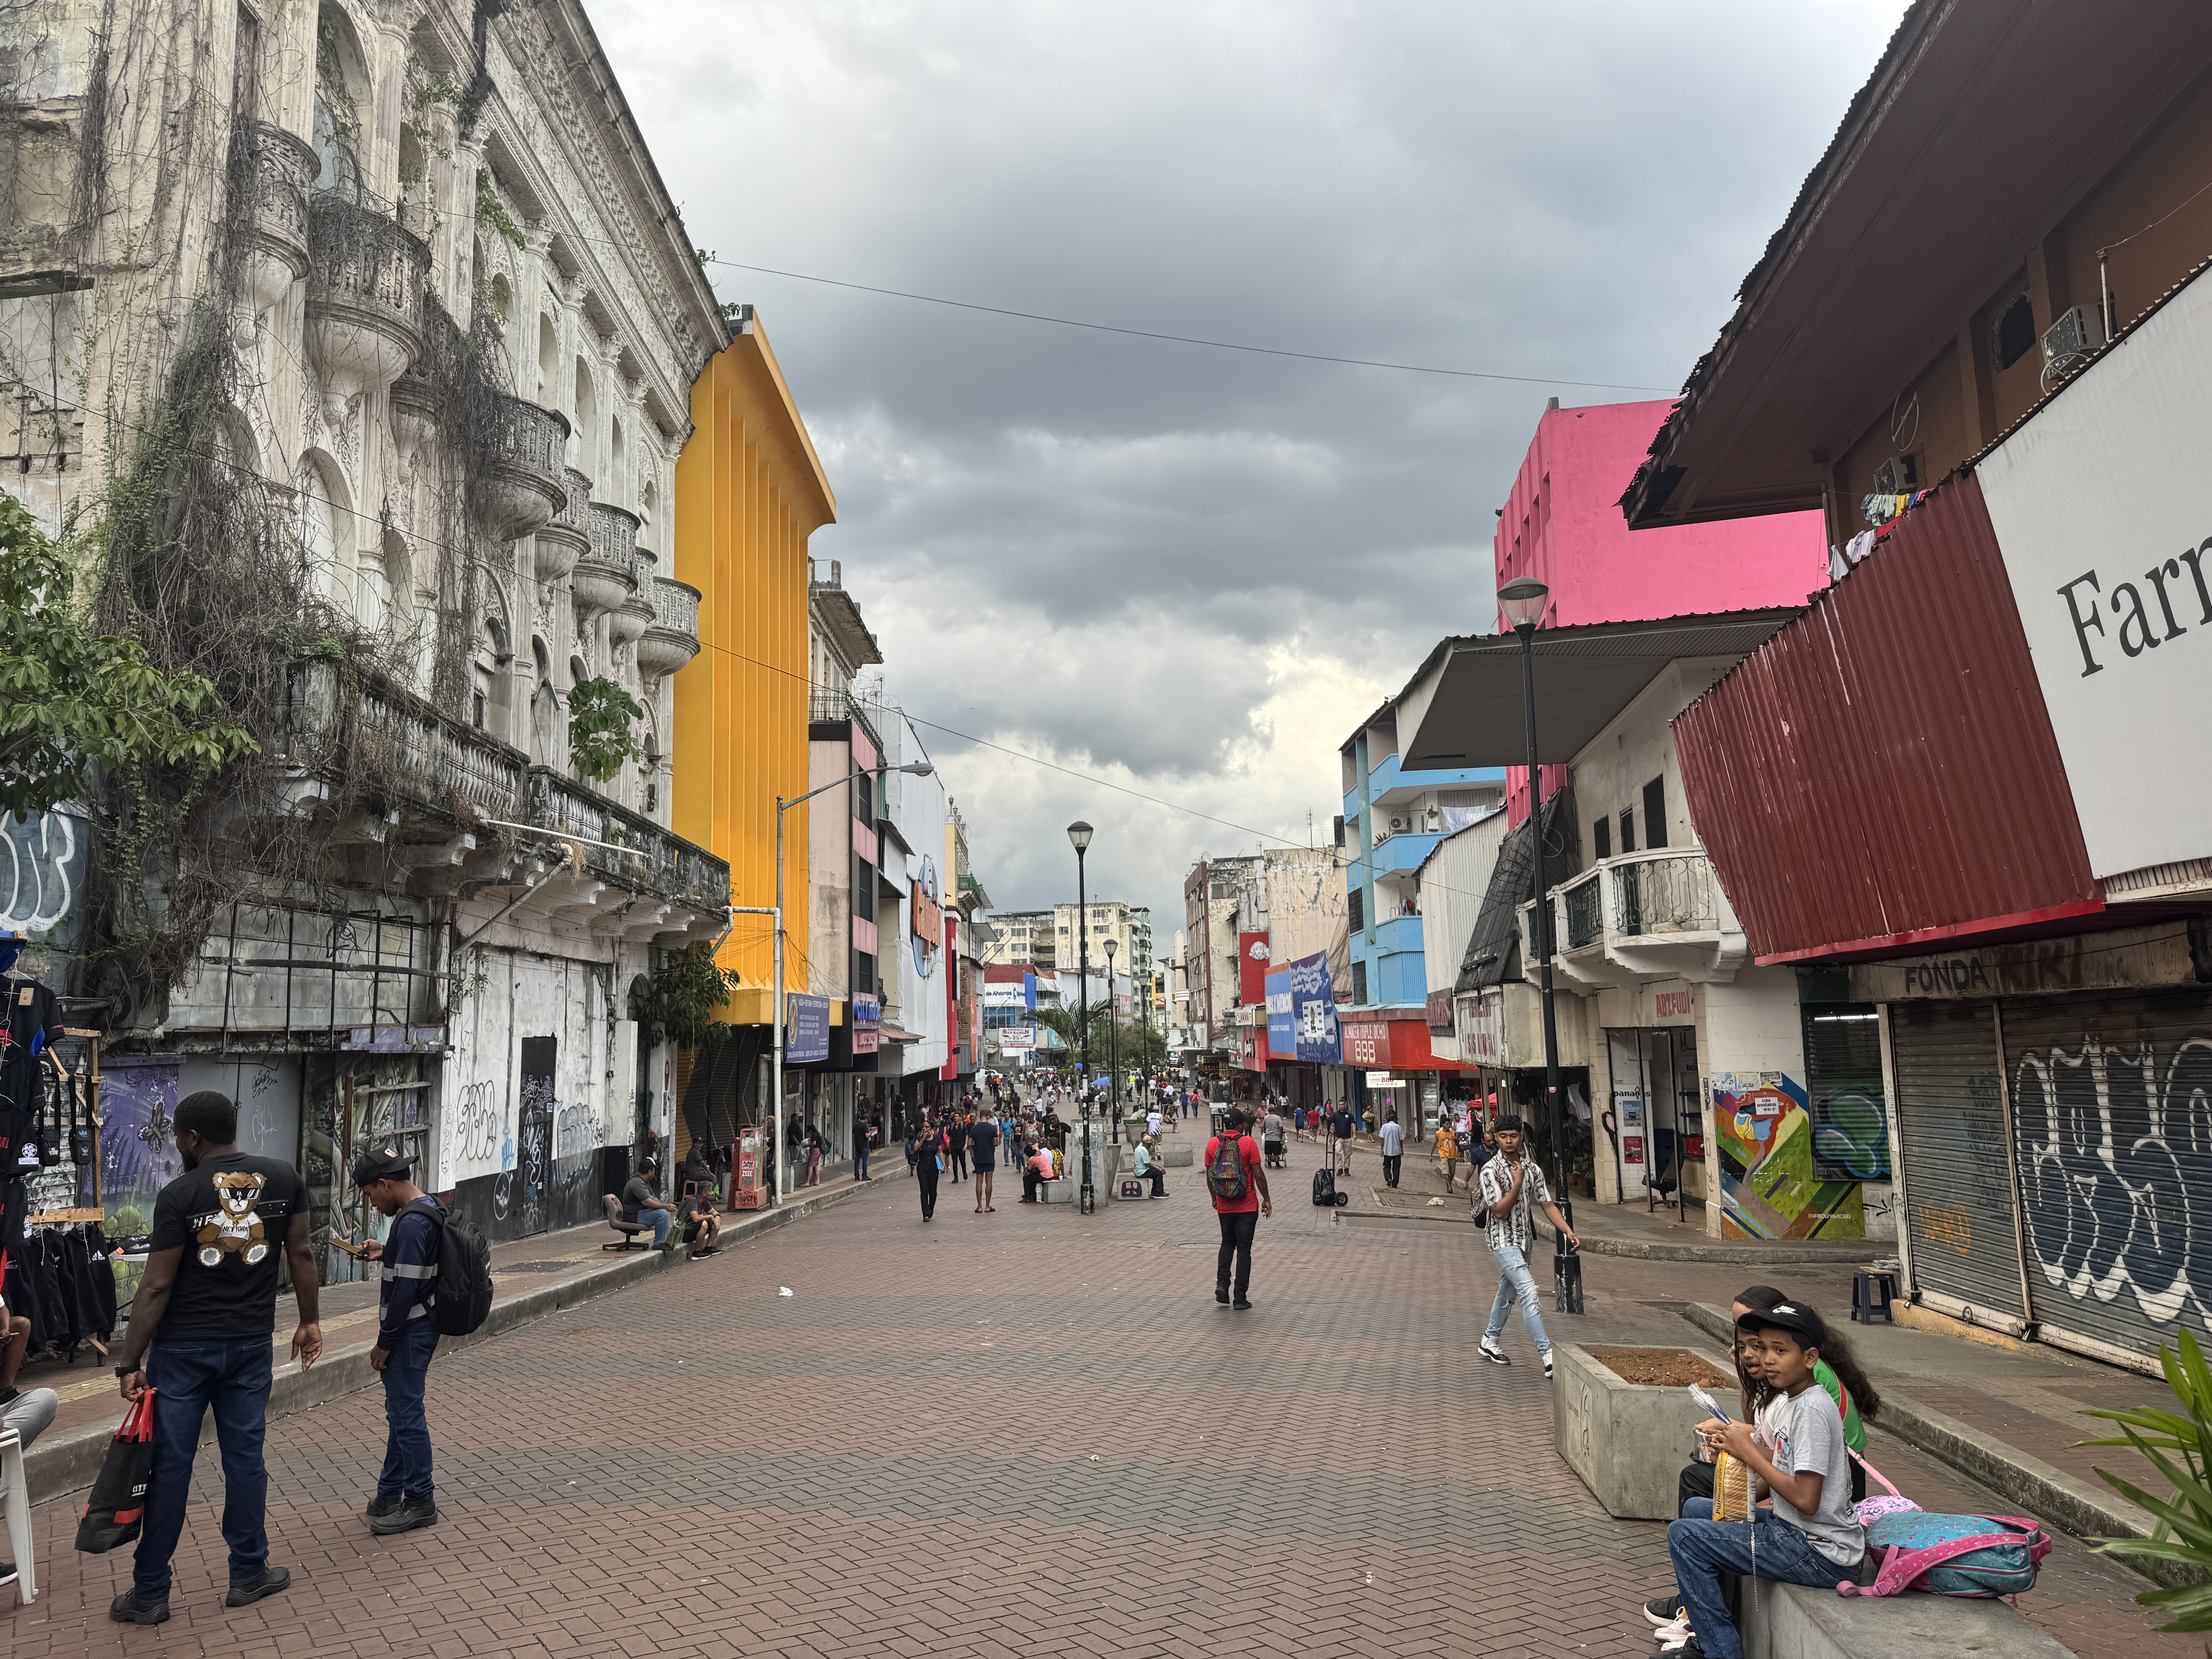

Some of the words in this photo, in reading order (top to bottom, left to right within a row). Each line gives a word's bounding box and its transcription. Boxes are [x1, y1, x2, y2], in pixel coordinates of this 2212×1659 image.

[1905, 957, 1990, 993] FONDA
[1277, 991, 1292, 1014] MENOS
[1345, 1025, 1360, 1039] ALMACEN
[1360, 1024, 1372, 1039] TRIPLE
[1374, 1024, 1386, 1040] OCHO
[1355, 1040, 1376, 1063] 888
